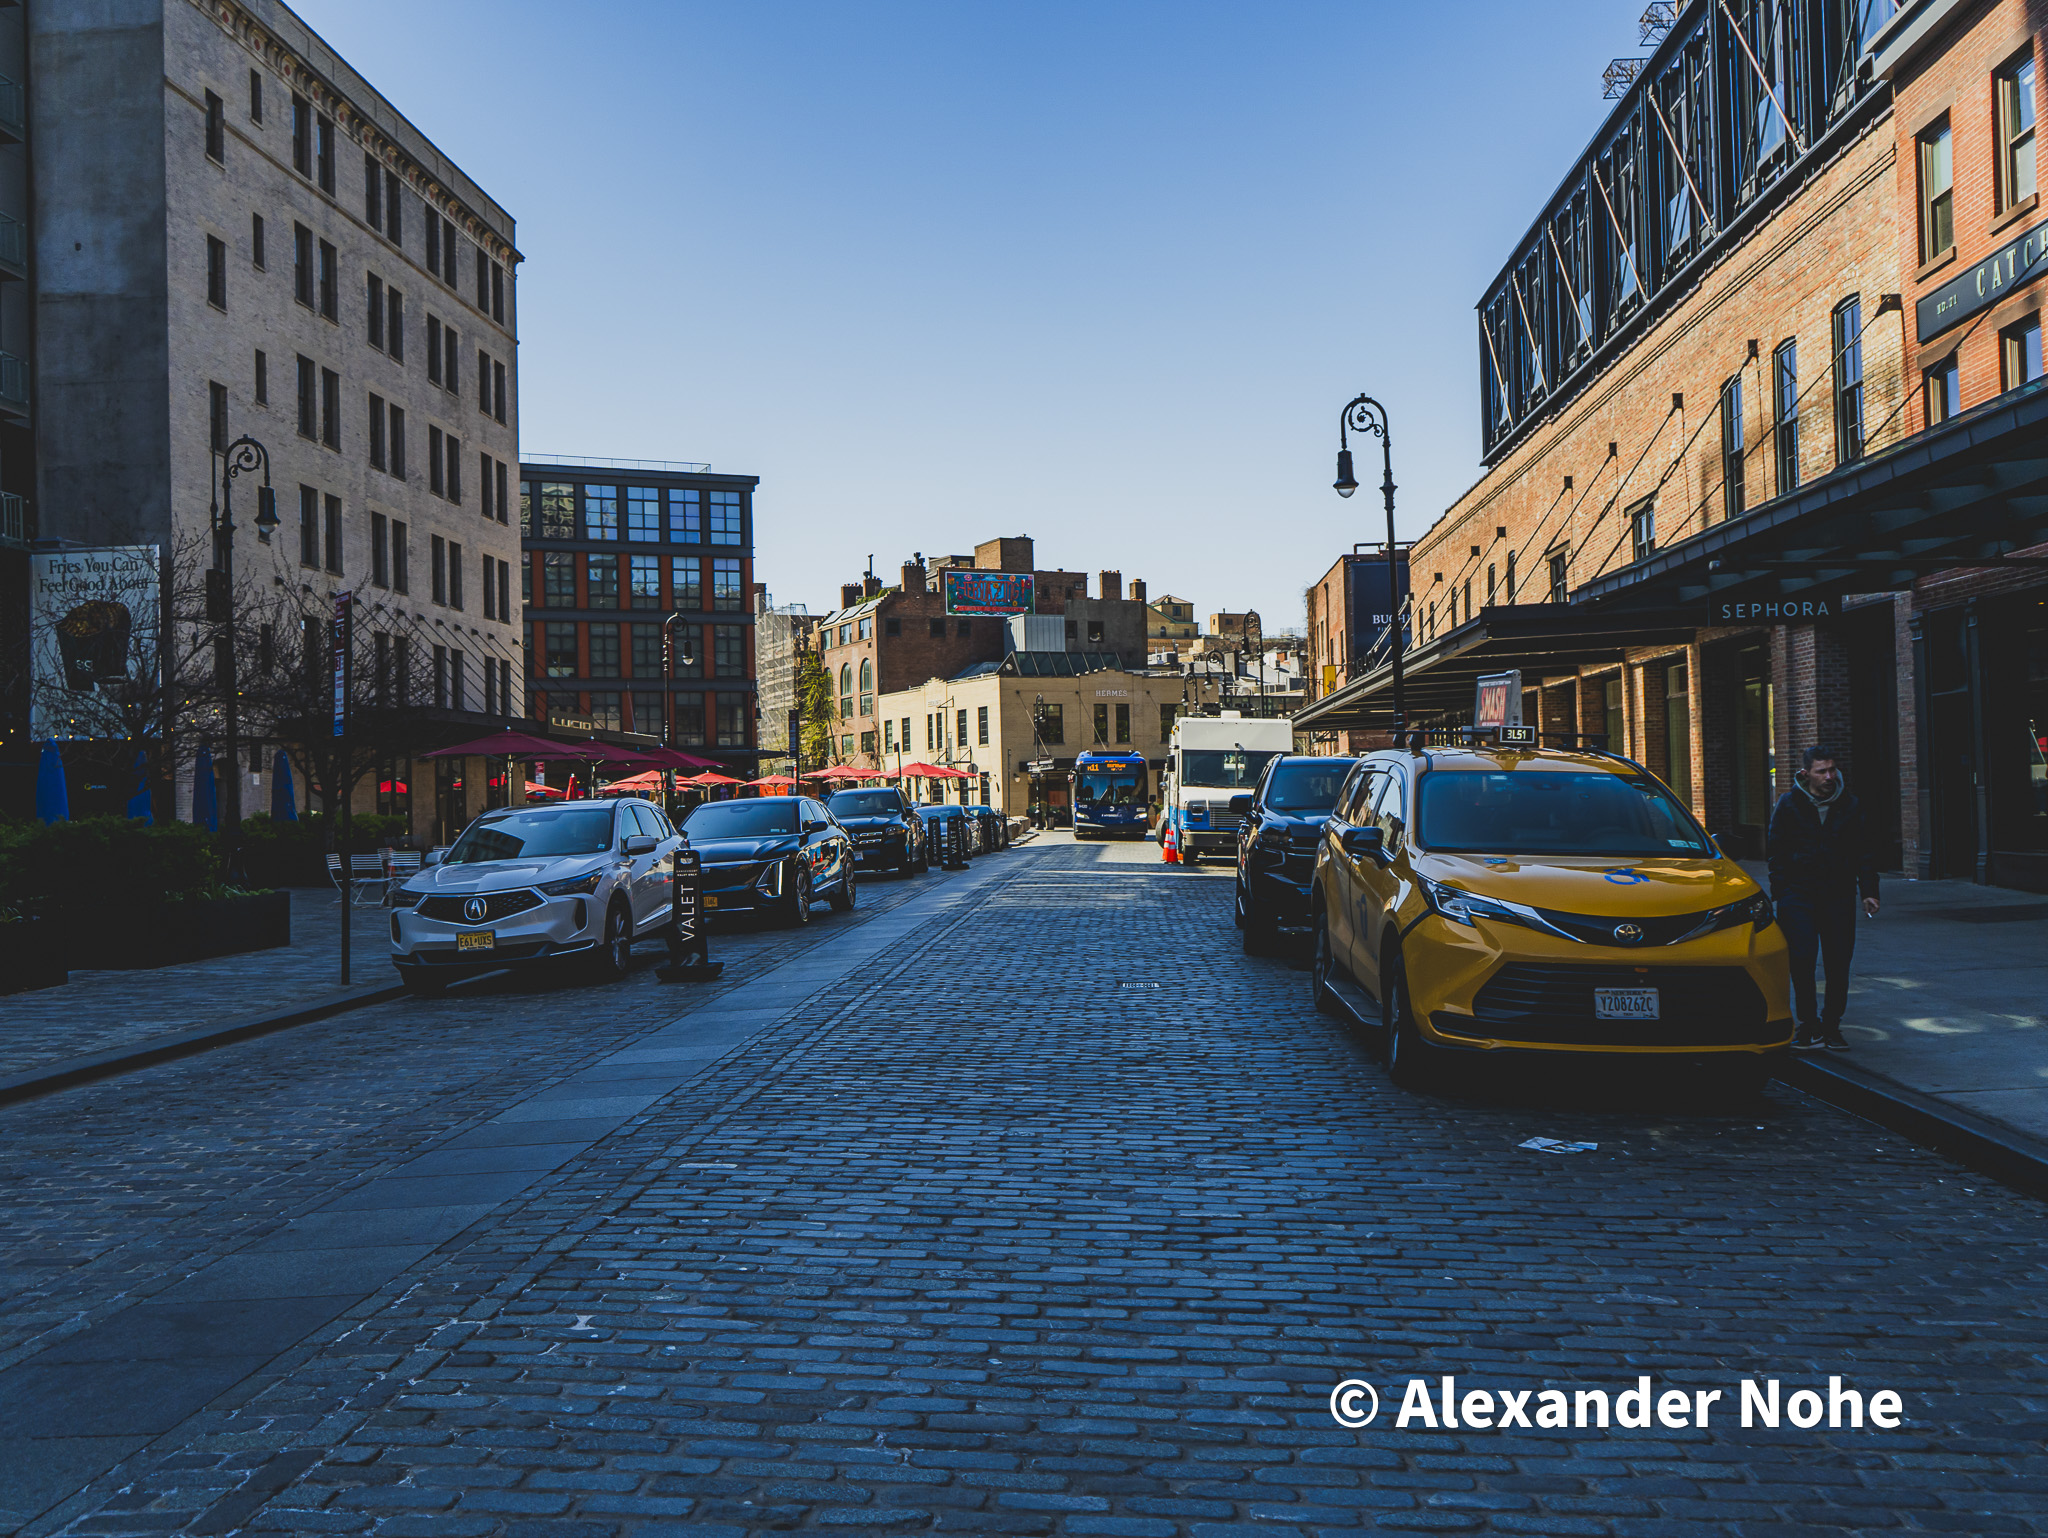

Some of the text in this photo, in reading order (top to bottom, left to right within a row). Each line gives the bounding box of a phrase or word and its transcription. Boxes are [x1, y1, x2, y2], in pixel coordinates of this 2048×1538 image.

[49, 557, 139, 574] Fries You Can
[40, 579, 66, 593] Feel
[68, 577, 105, 592] Good
[1722, 601, 1830, 619] SEPHORA
[1479, 686, 1506, 721] SMASH
[551, 717, 592, 731] LUCID
[1507, 729, 1527, 739] 3L51
[680, 884, 695, 941] VALET
[1600, 996, 1653, 1012] Y208262C
